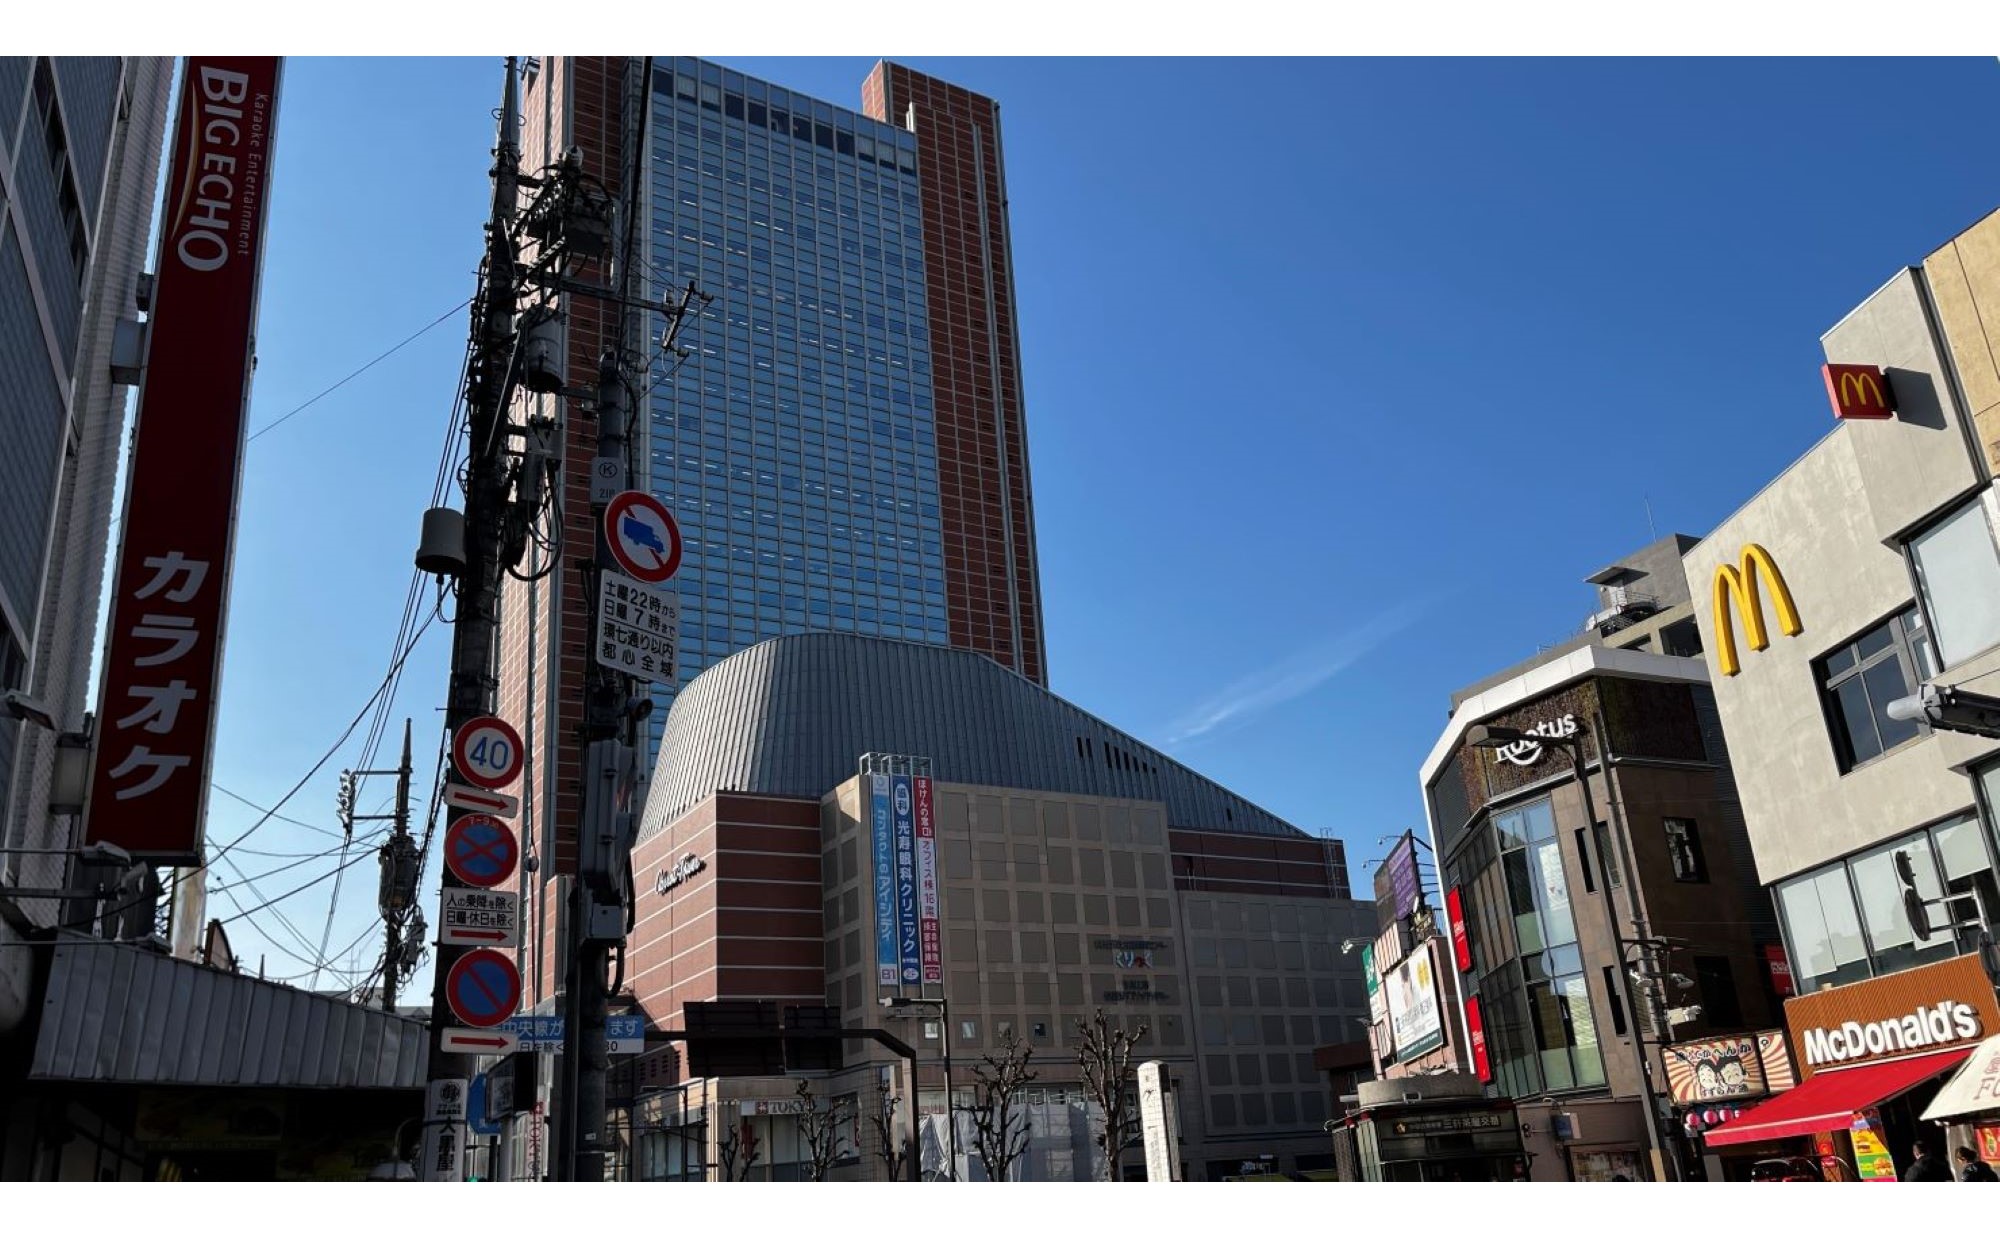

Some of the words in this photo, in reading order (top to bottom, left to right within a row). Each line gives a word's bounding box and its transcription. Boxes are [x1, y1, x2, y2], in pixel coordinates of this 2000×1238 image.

[200, 66, 249, 147] BIG
[249, 92, 270, 147] Karaoke
[177, 154, 236, 272] ECHO
[238, 152, 262, 256] Entertainment
[605, 579, 677, 620] 土曜22時から
[601, 642, 674, 679] 都心全域
[603, 621, 675, 660] 環七通り以内
[109, 551, 209, 801] カラオケ
[470, 736, 509, 771] 40
[1804, 1000, 1979, 1066] McDonald's
